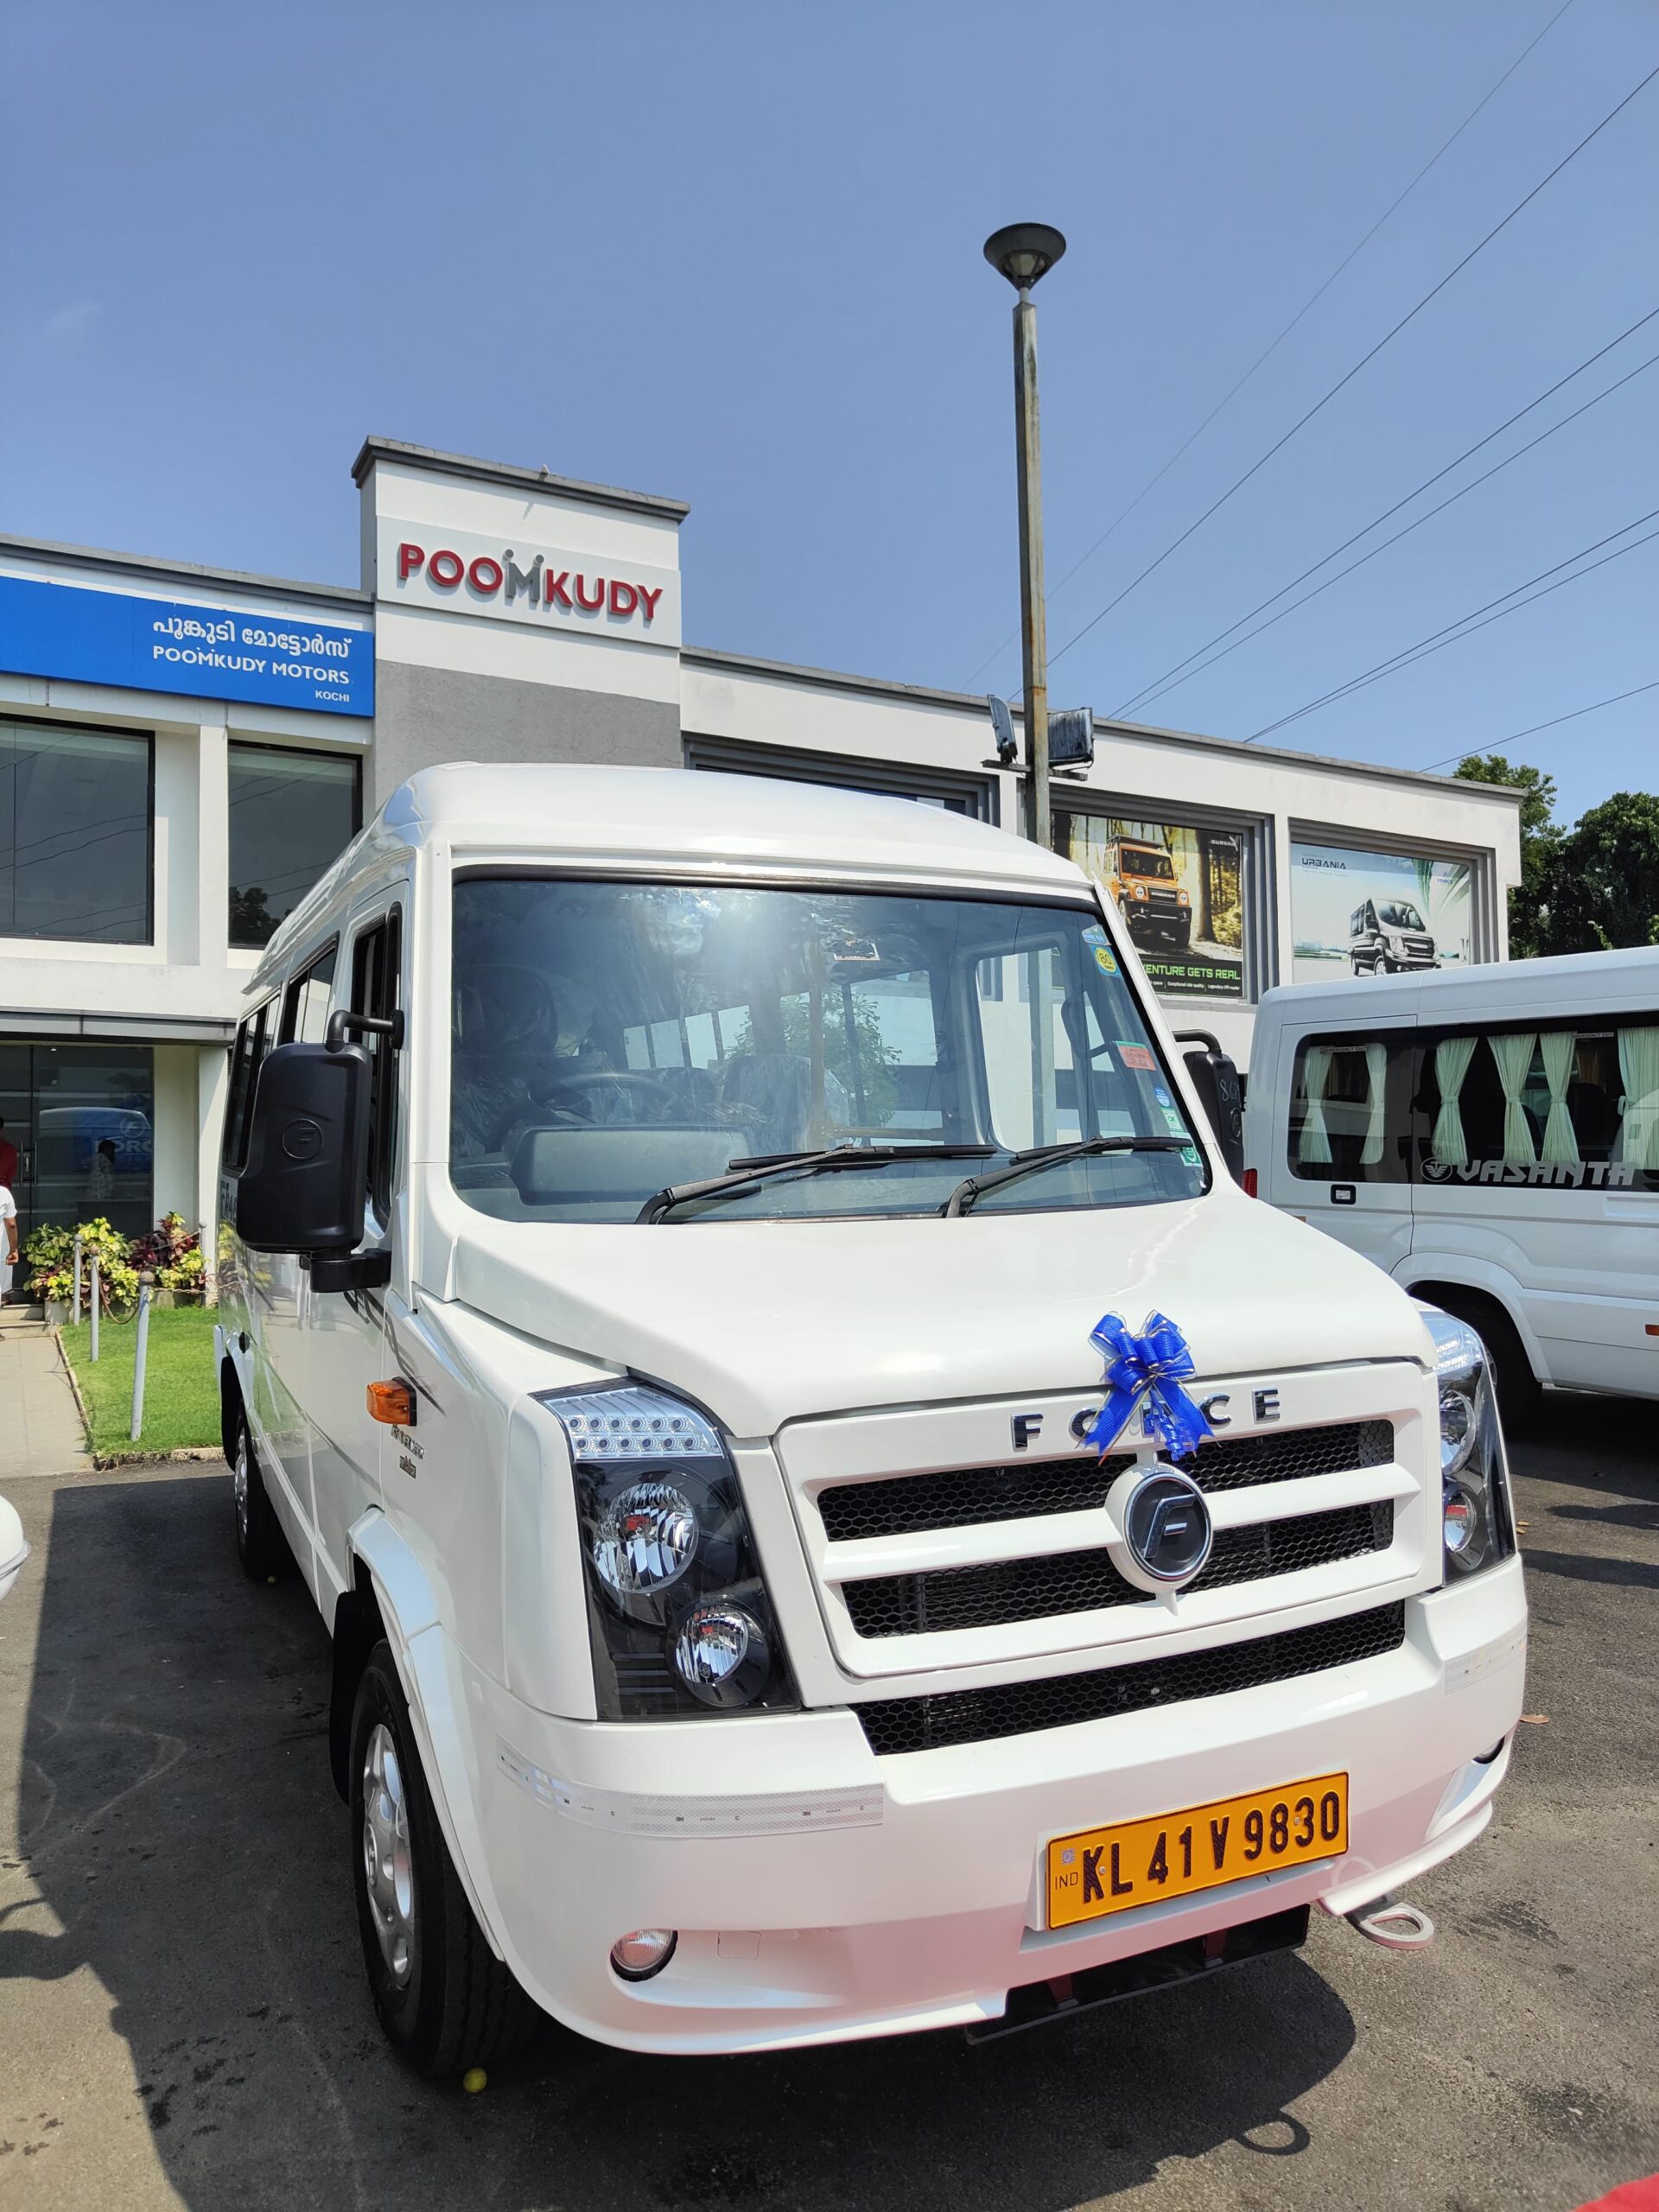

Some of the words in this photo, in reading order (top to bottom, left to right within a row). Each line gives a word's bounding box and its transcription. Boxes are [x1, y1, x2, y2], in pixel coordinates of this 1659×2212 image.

[400, 543, 664, 620] POOMKUDY
[153, 645, 266, 673] POOMKUDY
[272, 662, 350, 684] MOTORS
[315, 690, 350, 702] KOCHI
[1301, 857, 1346, 870] URBANIA
[1099, 953, 1112, 964] 80
[1187, 966, 1213, 978] GETS
[1215, 969, 1241, 981] REAL
[1456, 1159, 1637, 1188] VASANTA
[1082, 1841, 1134, 1904] KL
[1147, 1825, 1192, 1885] 41
[1209, 1815, 1230, 1870] V
[1243, 1790, 1340, 1861] 9830
[1054, 1872, 1078, 1891] IND
